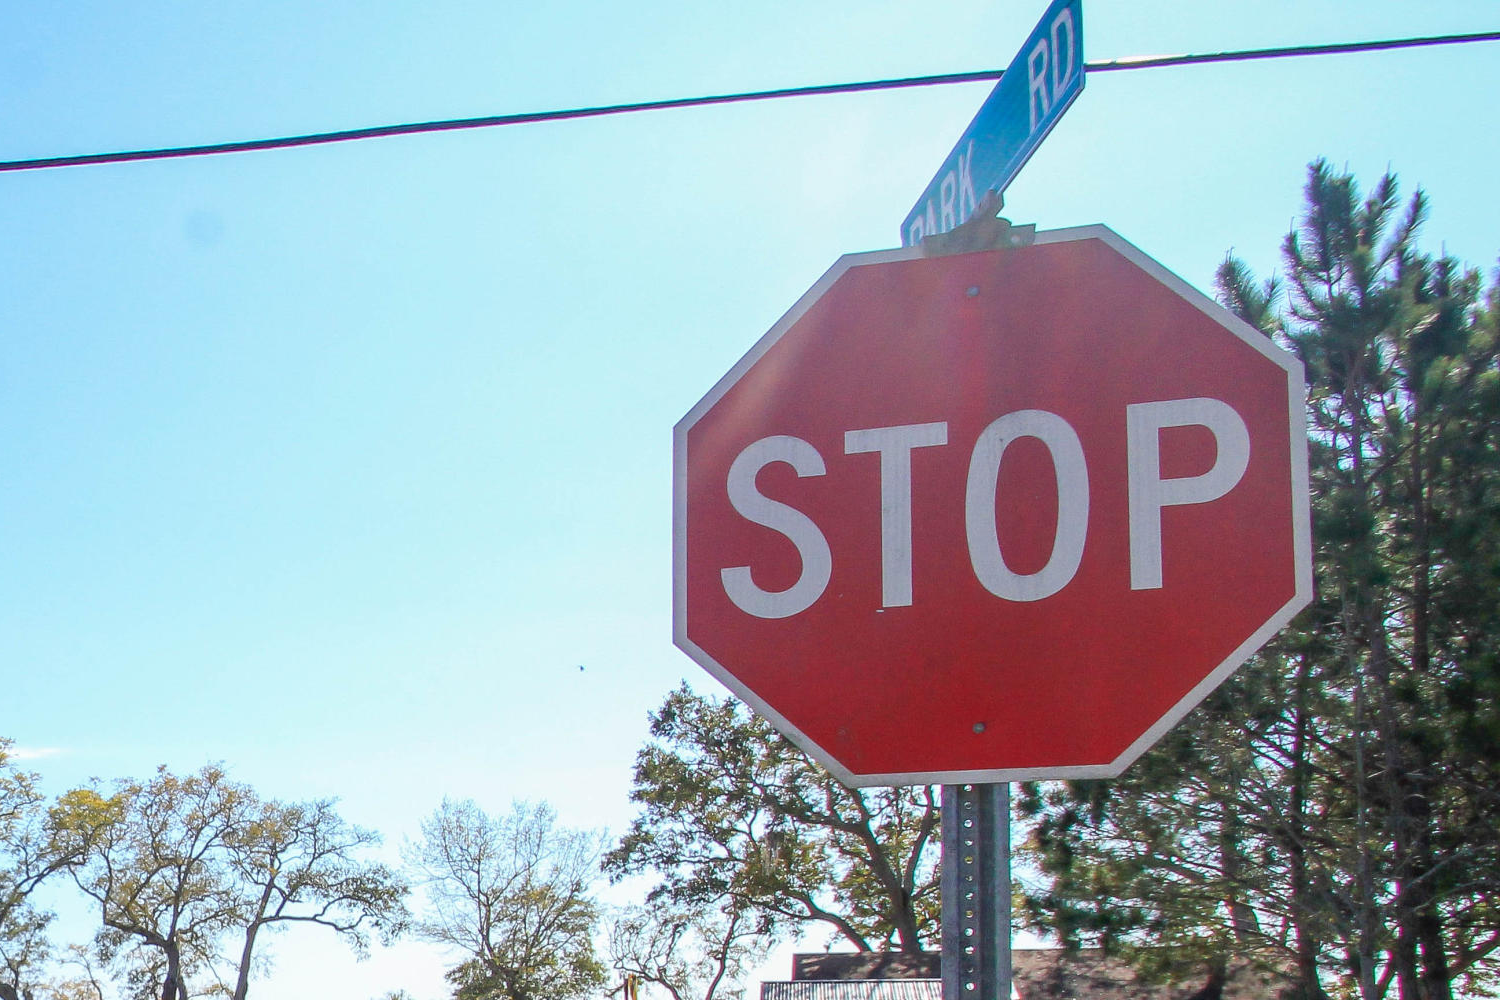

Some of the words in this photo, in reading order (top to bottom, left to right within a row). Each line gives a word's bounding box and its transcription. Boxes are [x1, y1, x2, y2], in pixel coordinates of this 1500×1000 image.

[910, 138, 977, 247] PARK
[1027, 7, 1075, 136] RD
[720, 397, 1251, 619] STOP
